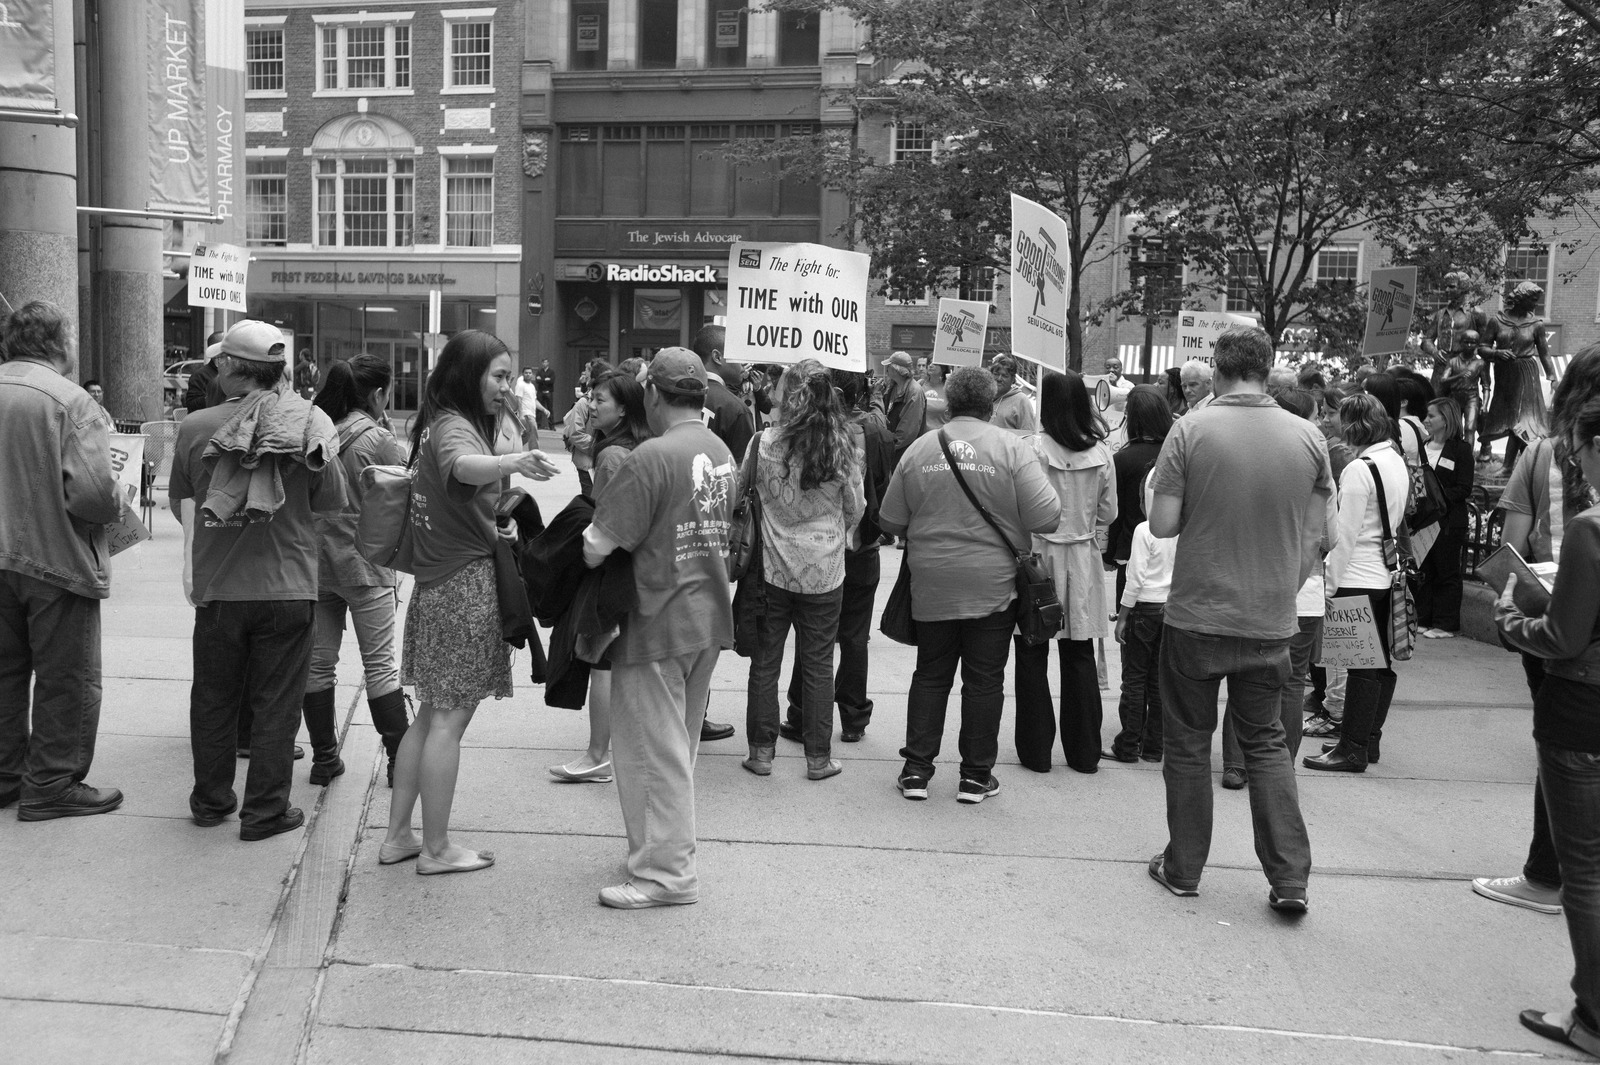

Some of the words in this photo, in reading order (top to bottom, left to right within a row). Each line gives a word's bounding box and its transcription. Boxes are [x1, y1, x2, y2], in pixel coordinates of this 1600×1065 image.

[165, 13, 189, 121] MARKET
[167, 129, 190, 164] UP
[216, 105, 233, 218] PHARMACY
[627, 230, 649, 243] The
[652, 230, 690, 245] Jewish
[694, 230, 742, 243] Advocate
[740, 258, 759, 267] SEIU
[1016, 229, 1044, 272] GOOD
[1045, 252, 1066, 285] STRONG
[193, 265, 215, 280] TIME
[219, 269, 234, 282] with
[235, 271, 245, 285] OUR
[607, 264, 718, 283] RadioShack
[769, 256, 788, 272] The
[793, 258, 823, 278] Fight
[825, 263, 841, 279] for:
[1015, 255, 1037, 288] JOBS
[271, 271, 302, 284] FIRST
[303, 271, 355, 284] FEDERAL
[357, 272, 405, 285] SAVINGS
[406, 273, 438, 285] BANK
[199, 286, 227, 301] LOVED
[229, 290, 241, 304] ONES
[1372, 286, 1392, 307] GOOD
[738, 286, 778, 311] TIME
[789, 290, 823, 315] with
[831, 296, 859, 323] OUR
[940, 322, 957, 336] JOBS
[941, 311, 962, 329] GOOD
[1027, 316, 1039, 327] SEIU
[1040, 322, 1055, 335] LOCAL
[1055, 327, 1064, 338] 615
[1198, 319, 1210, 329] The
[1211, 320, 1228, 331] Fight
[746, 324, 803, 349] LOVED
[813, 329, 849, 357] ONES
[1182, 335, 1204, 349] TIME
[113, 529, 139, 546] TIME
[1325, 606, 1372, 624] WORKERS
[1323, 625, 1358, 637] DESERVE
[1342, 640, 1365, 650] WAGE
[1354, 652, 1376, 666] TIME
